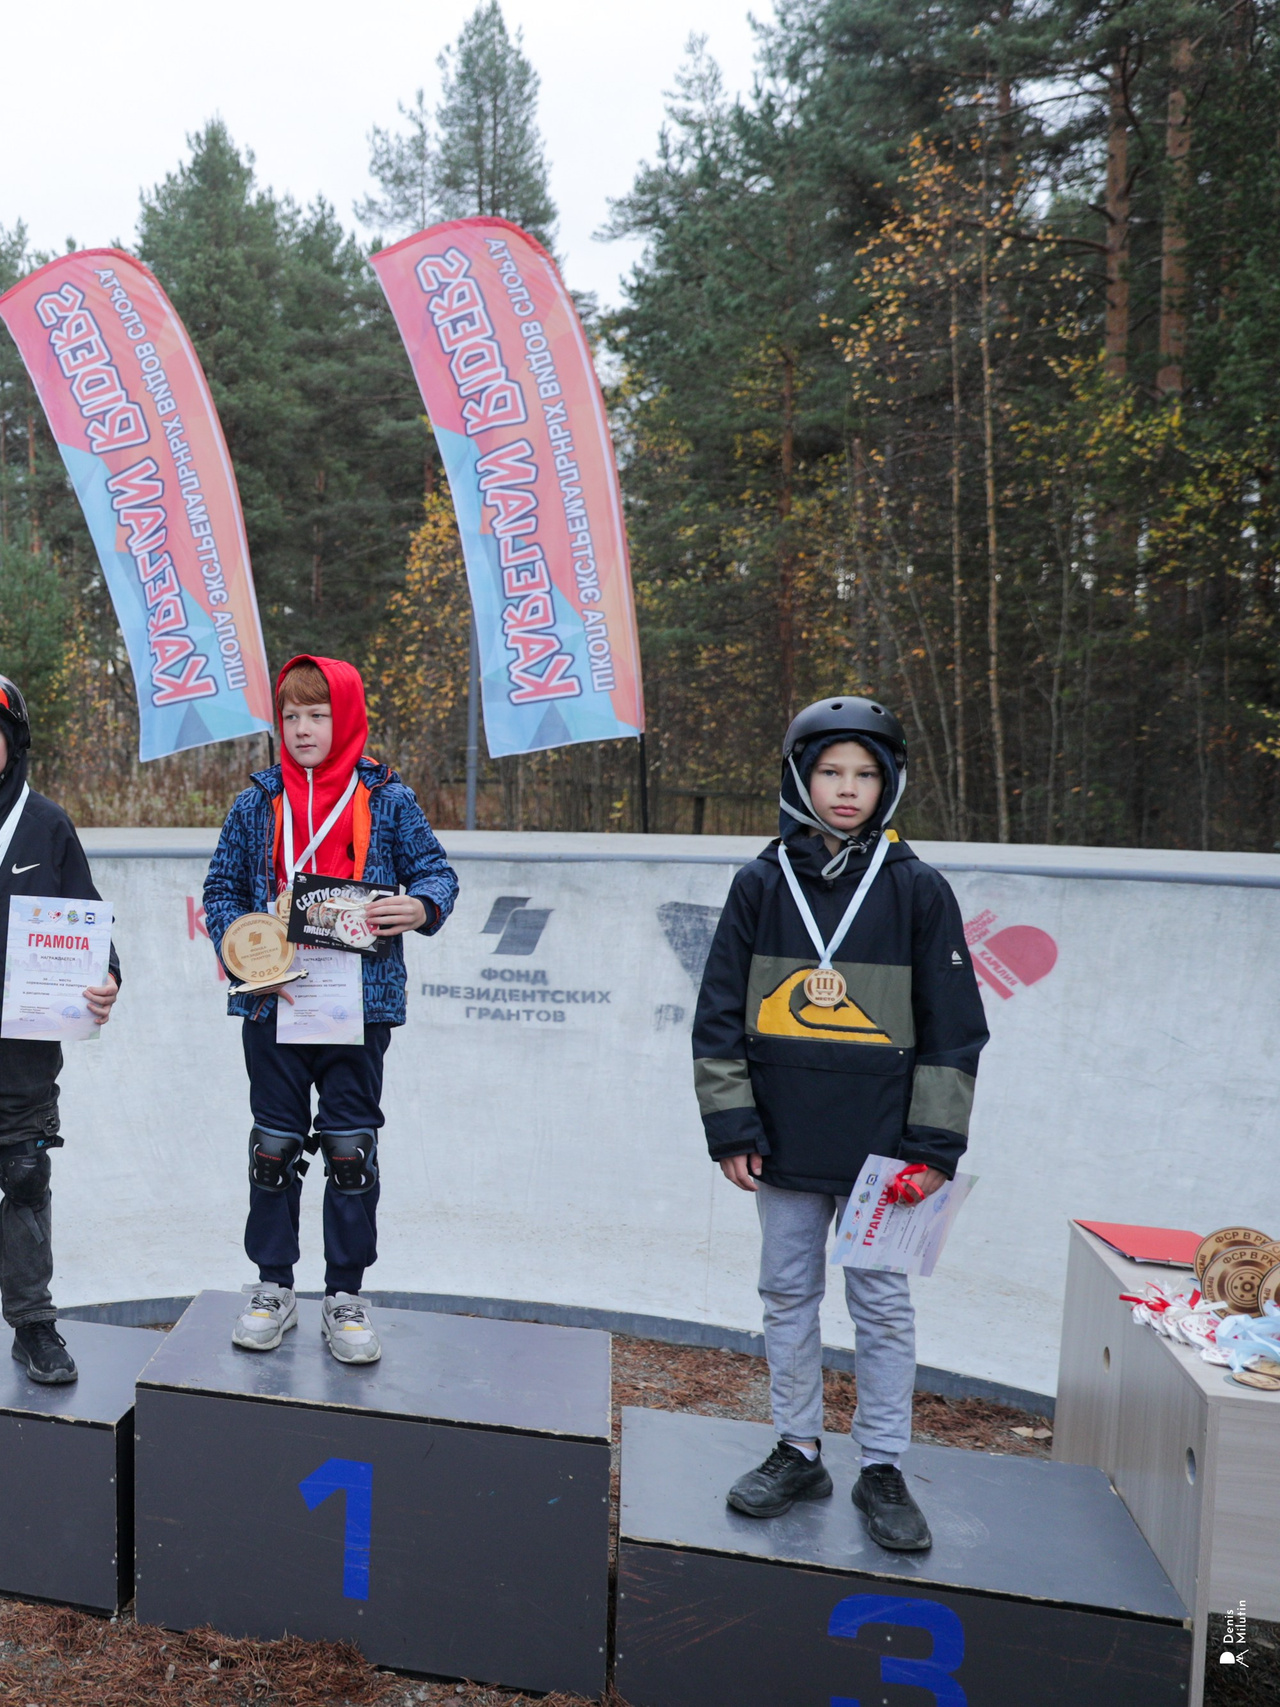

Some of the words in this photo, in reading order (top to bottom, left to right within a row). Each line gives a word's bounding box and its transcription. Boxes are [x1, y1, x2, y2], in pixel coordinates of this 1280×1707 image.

[28, 933, 89, 950] ГРАМОТА
[251, 965, 280, 978] 2025
[480, 968, 549, 986] ФОНД
[978, 950, 1019, 987] КАРЕЛИЯ
[421, 983, 612, 1004] ПРЕЗИДЕНТСКИХ
[465, 1006, 566, 1023] ГРАНТОВ
[862, 1187, 890, 1246] ГРАМОТ
[1214, 1231, 1239, 1244] ФСР
[1243, 1232, 1251, 1240] В
[1222, 1251, 1247, 1264] ФСР
[1250, 1251, 1258, 1259] В
[1260, 1254, 1275, 1267] РК
[297, 1457, 374, 1600] 1
[827, 1593, 969, 1707] 3
